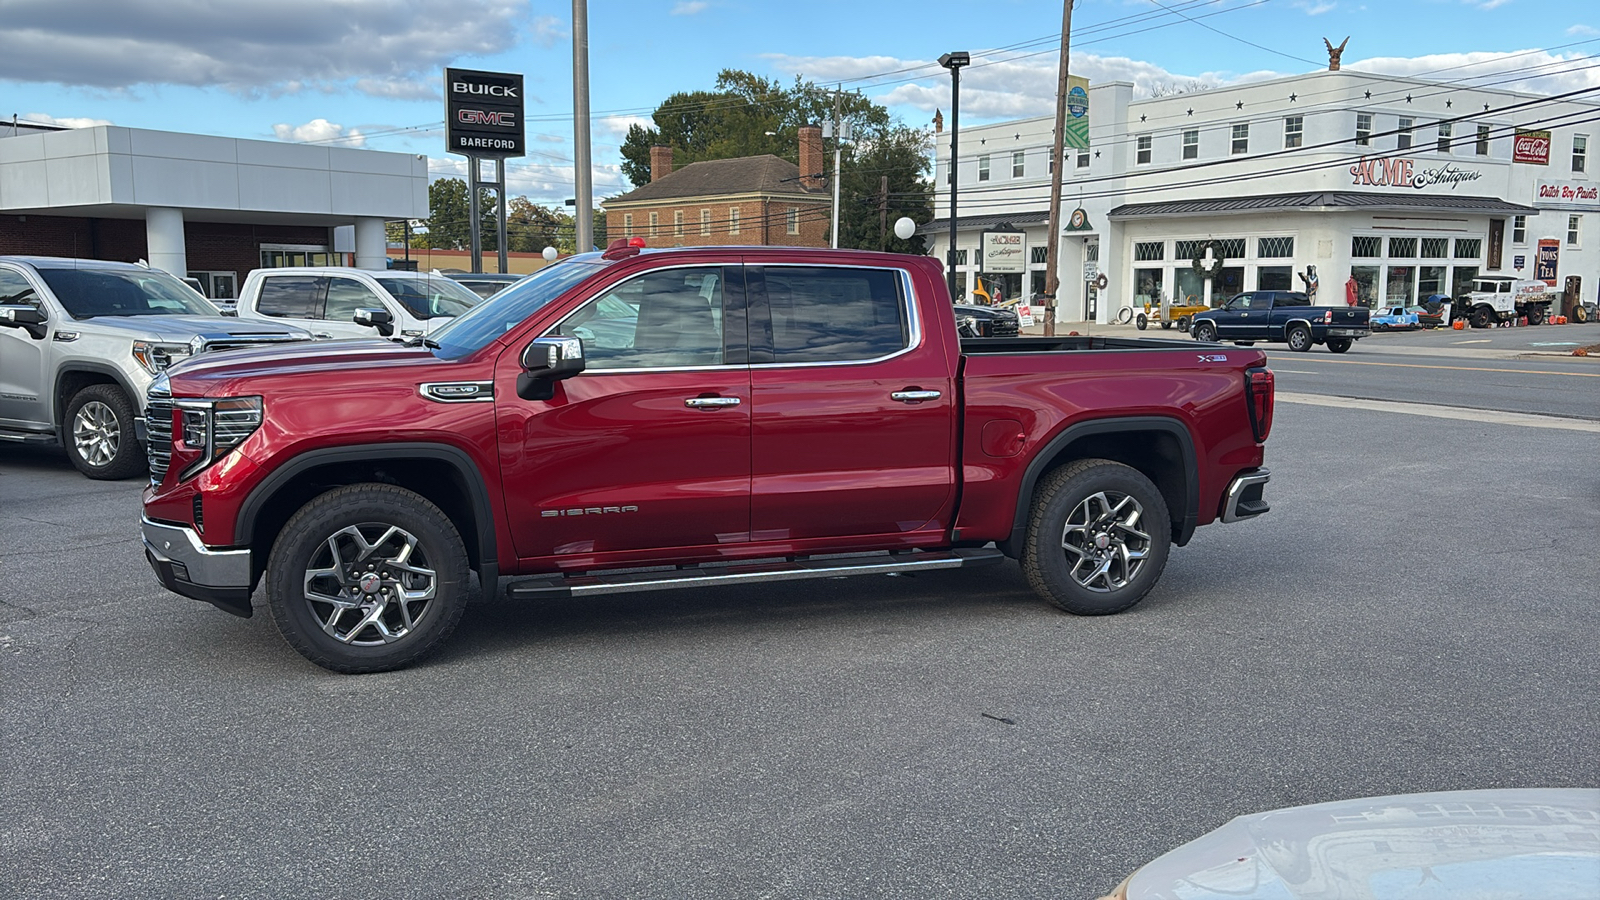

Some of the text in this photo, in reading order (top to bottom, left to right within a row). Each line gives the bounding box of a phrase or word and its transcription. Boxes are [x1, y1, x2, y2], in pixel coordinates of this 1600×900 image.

[453, 82, 518, 98] BUICK
[458, 109, 515, 127] GMC
[460, 137, 515, 149] BAREFORD
[1350, 155, 1414, 187] ACME
[1540, 184, 1598, 202] Dutch Boy Paints
[1085, 272, 1096, 280] 25
[1541, 266, 1554, 278] TEA
[541, 505, 639, 518] SIERRA
